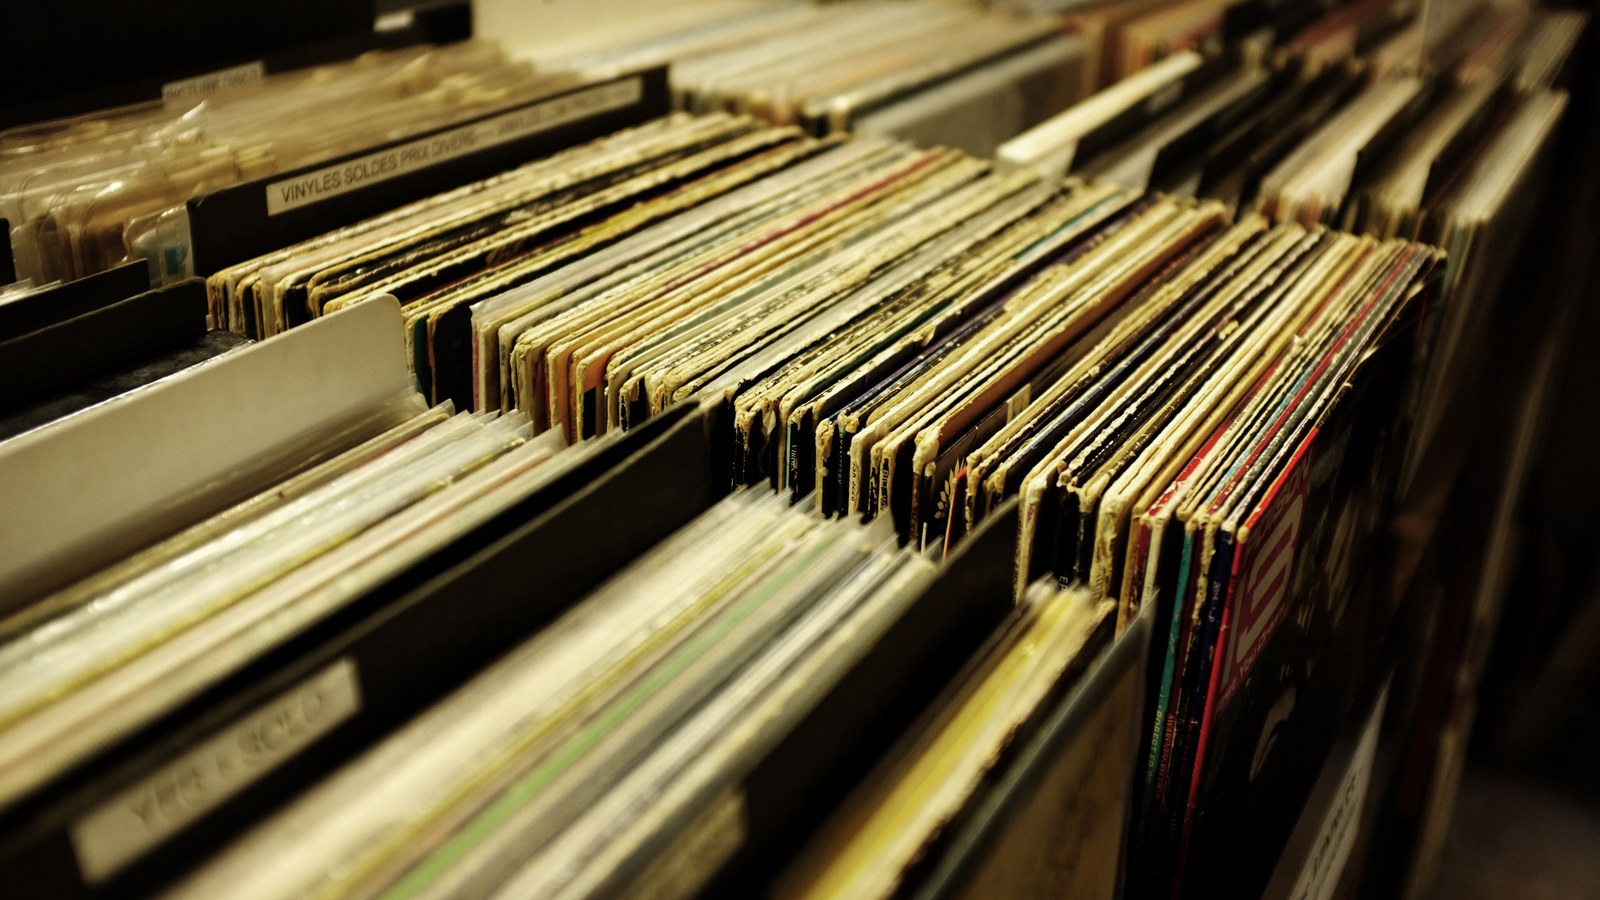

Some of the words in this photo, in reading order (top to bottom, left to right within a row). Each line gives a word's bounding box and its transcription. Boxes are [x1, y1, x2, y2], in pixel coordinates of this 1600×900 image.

[280, 170, 342, 204] VINYLES
[342, 152, 398, 184] SOLDES
[400, 142, 428, 165] PRIX
